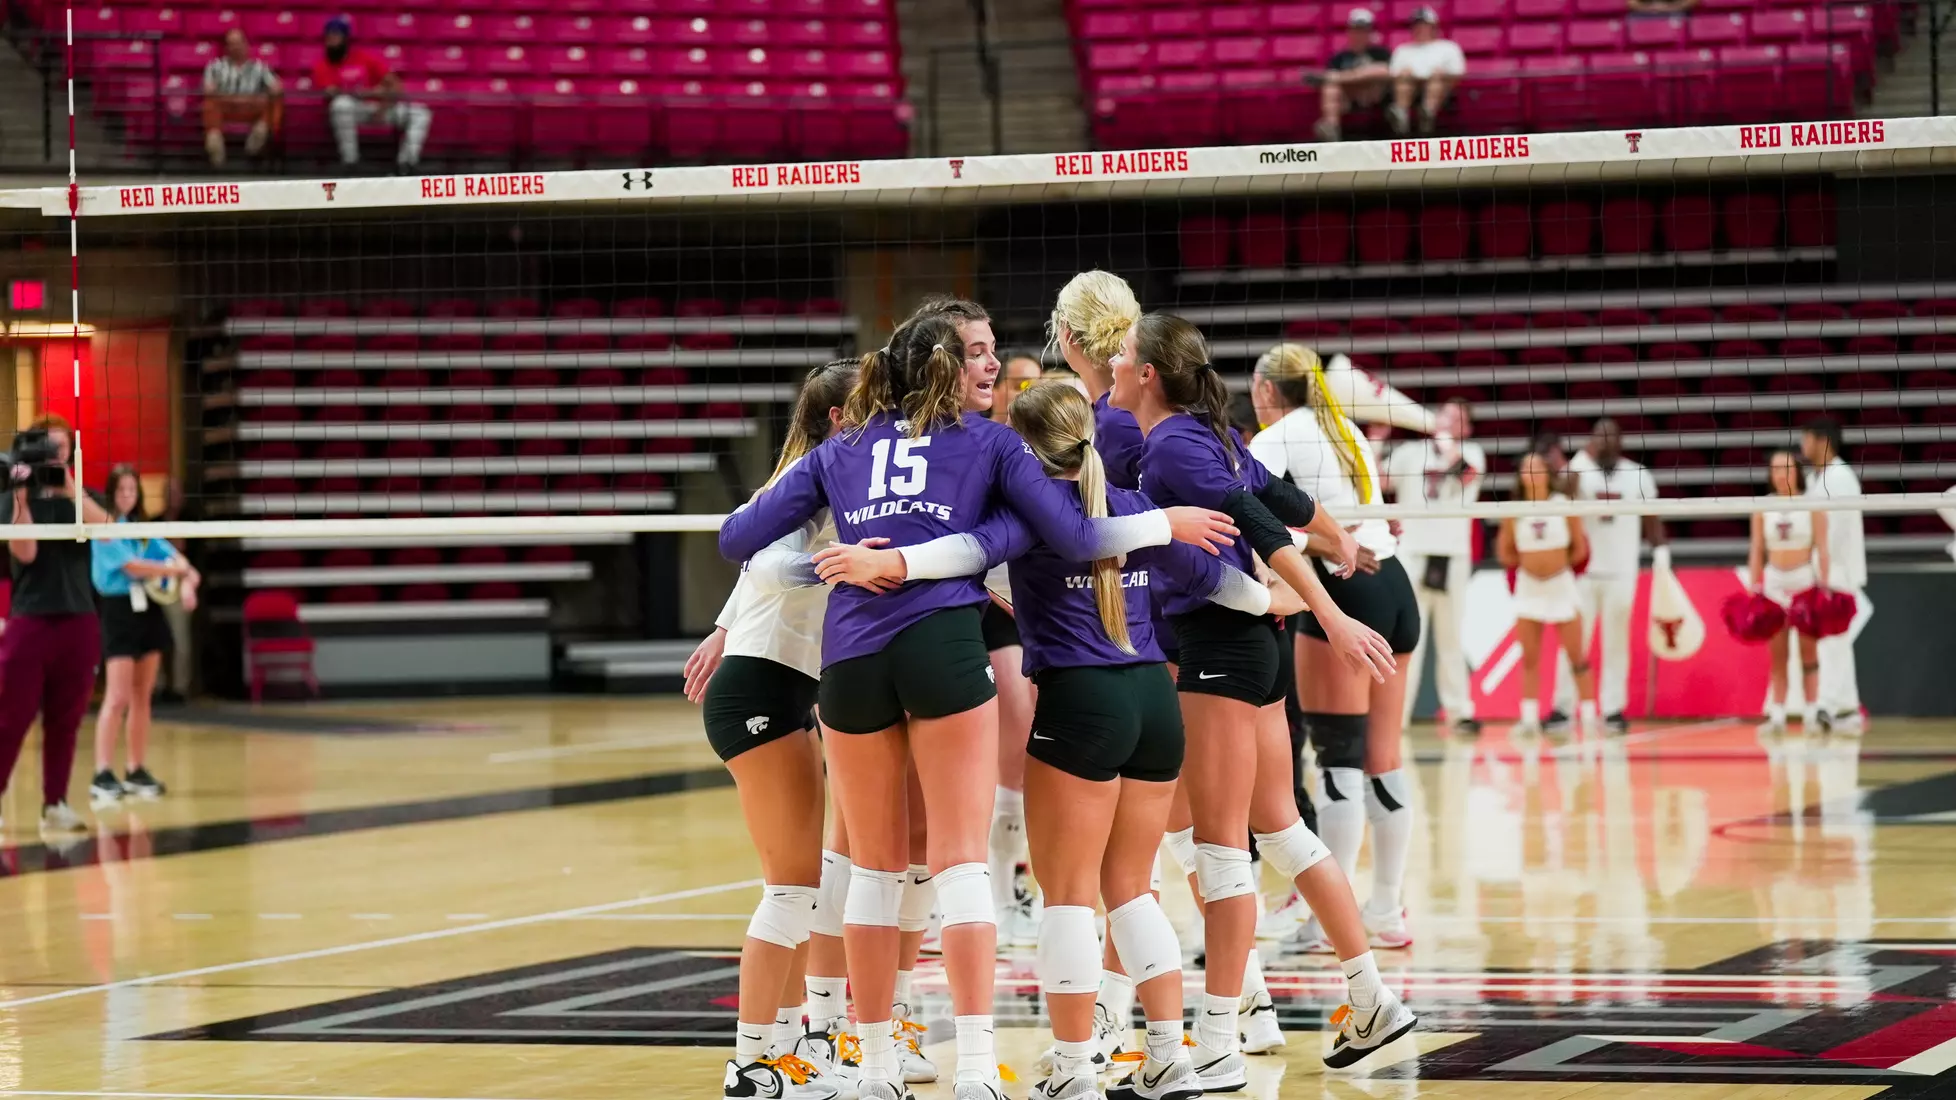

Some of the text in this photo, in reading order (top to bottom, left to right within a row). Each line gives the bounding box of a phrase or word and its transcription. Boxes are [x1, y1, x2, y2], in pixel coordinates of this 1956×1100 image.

[1741, 121, 1885, 148] RED RAIDERS
[1259, 148, 1318, 164] molten
[1391, 136, 1530, 163] RED RAIDERS
[1056, 151, 1189, 175] RED RAIDERS
[421, 175, 545, 198] RED RAIDERS
[732, 164, 861, 188] RED RAIDERS
[120, 185, 241, 208] RED RAIDERS
[868, 435, 932, 501] 15
[843, 498, 953, 525] WILDCATS
